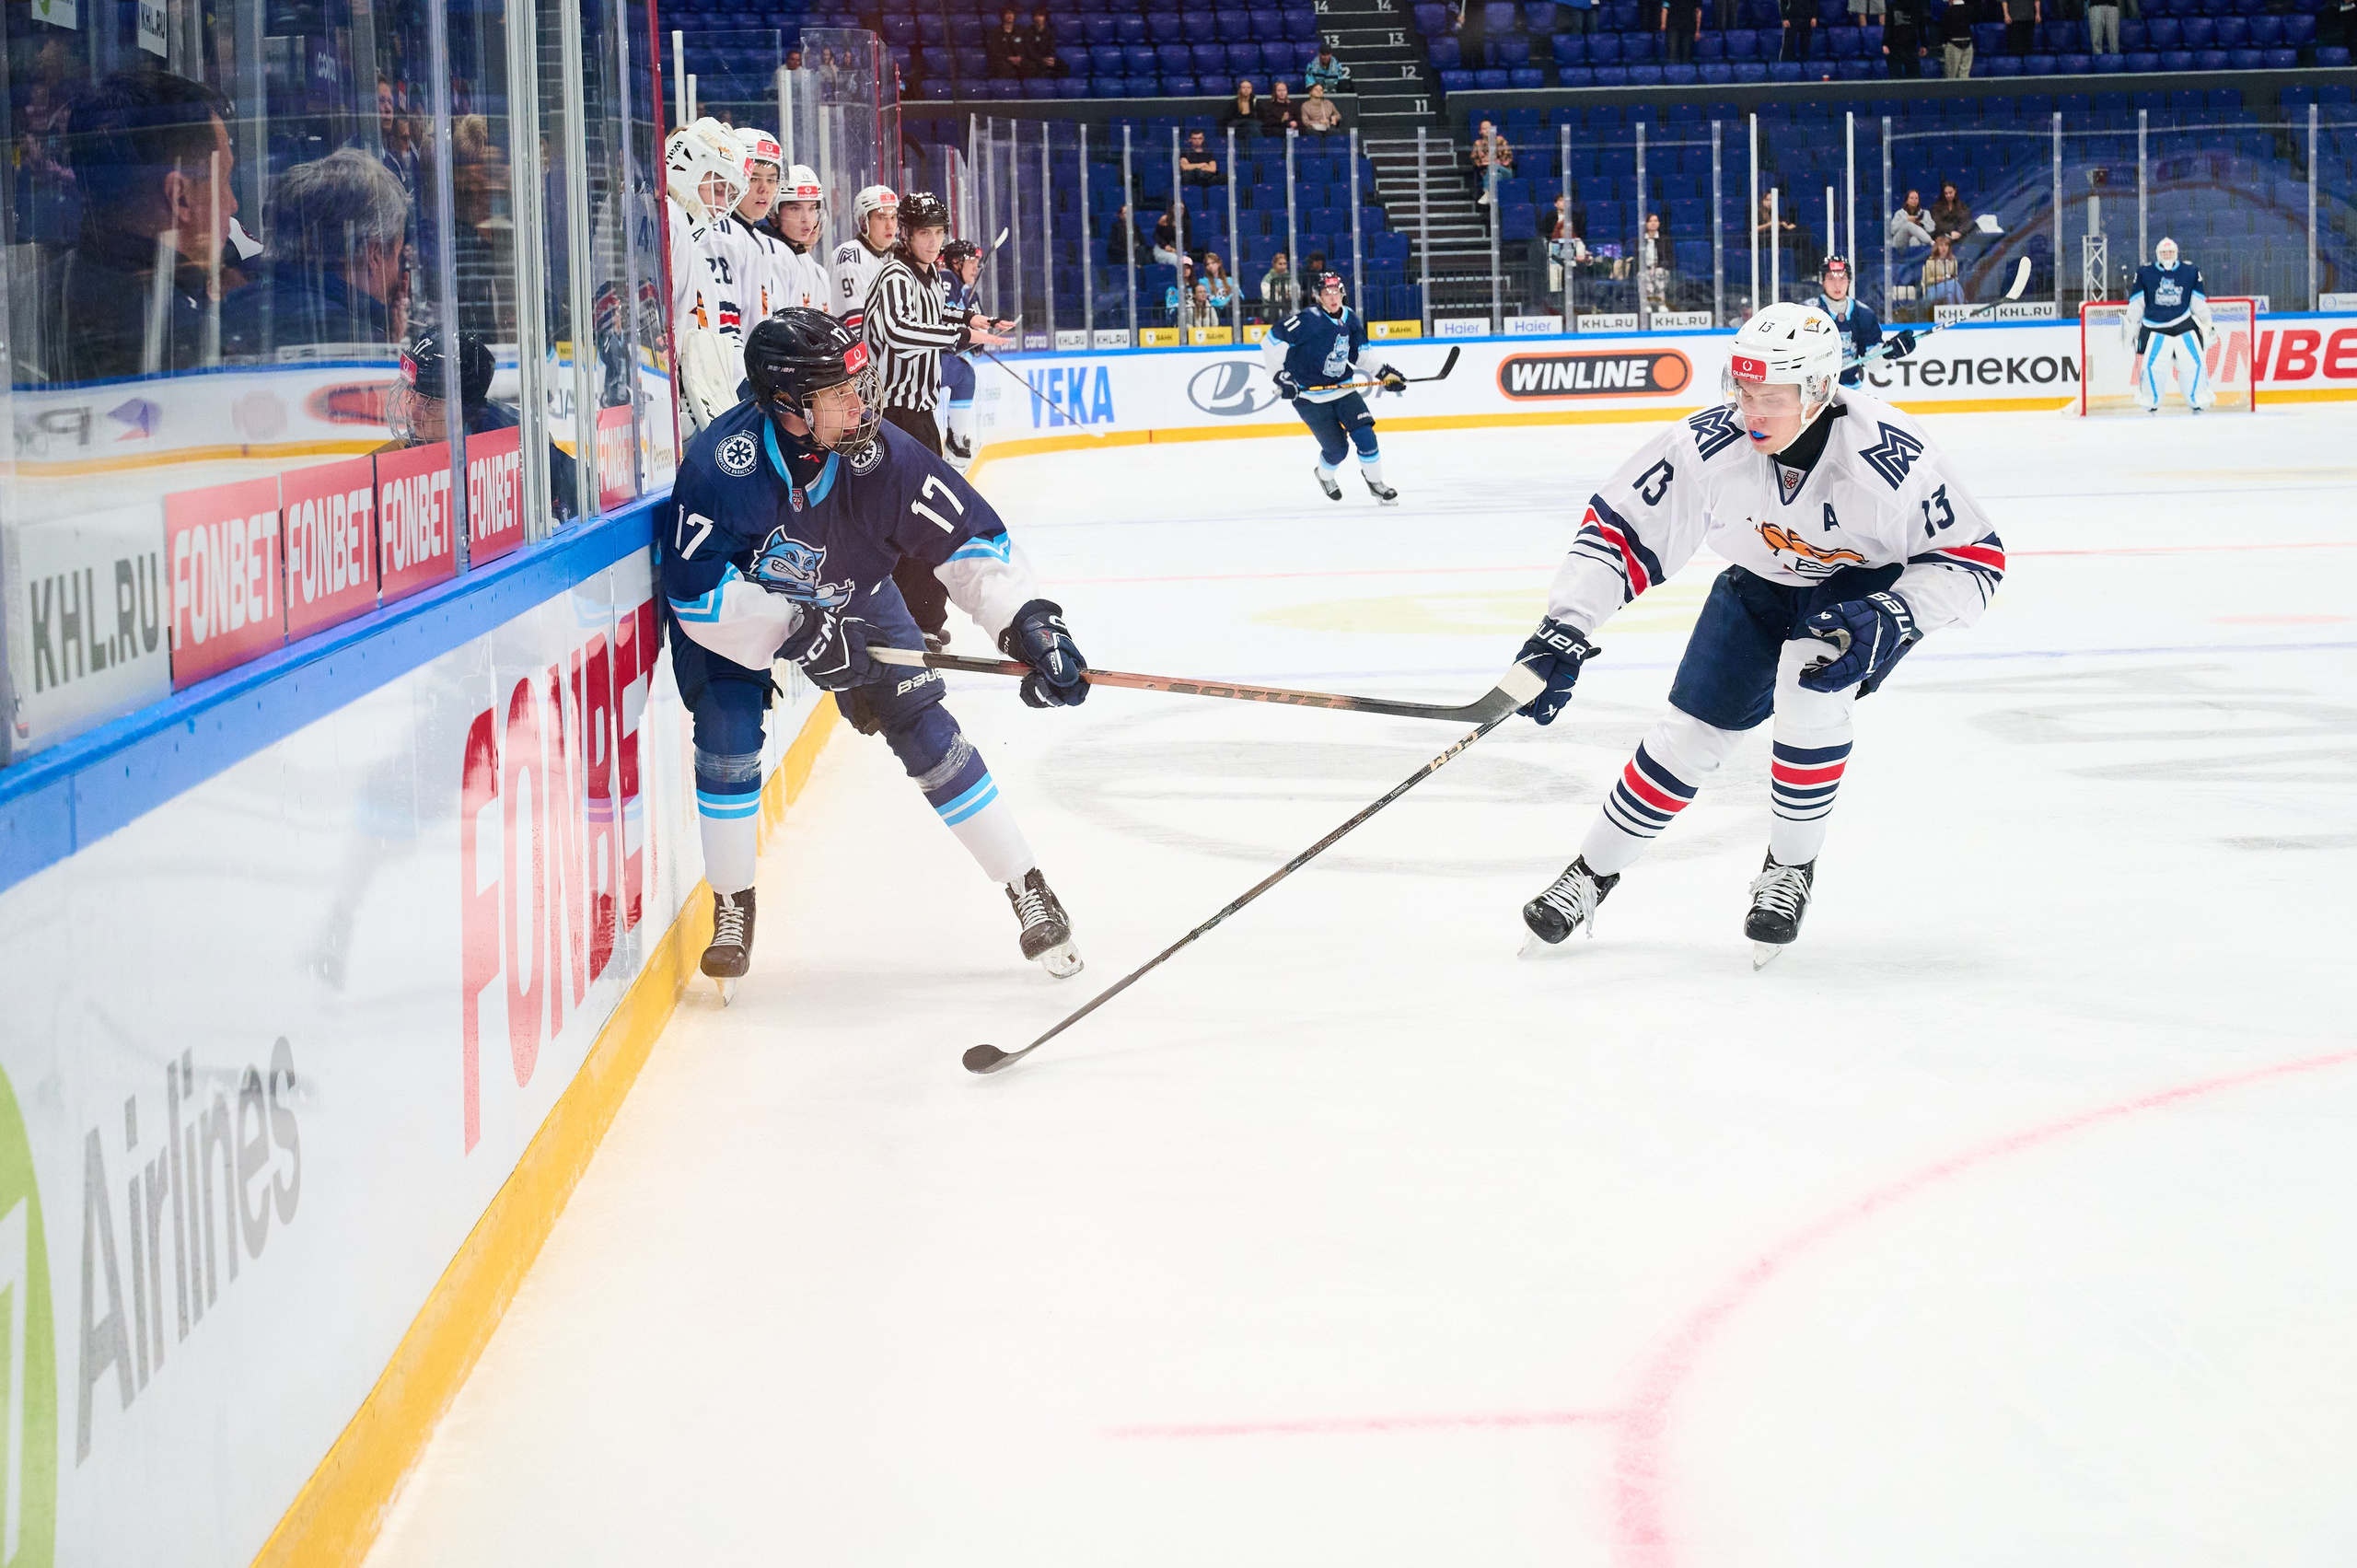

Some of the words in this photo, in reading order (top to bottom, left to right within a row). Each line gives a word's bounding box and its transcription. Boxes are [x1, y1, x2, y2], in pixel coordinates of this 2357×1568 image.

[1314, 0, 1329, 13] 14
[1376, 0, 1391, 11] 14
[1323, 35, 1340, 46] 13
[1388, 32, 1404, 44] 13
[1401, 66, 1416, 77] 12
[1415, 99, 1427, 111] 11
[1655, 316, 1708, 327] KHL.RU
[2000, 306, 2053, 317] KHL.RU
[830, 327, 851, 344] 17
[1445, 322, 1479, 335] Haier
[1515, 320, 1550, 333] Haier
[1582, 318, 1634, 330] KHL.RU
[1759, 321, 1775, 333] 13
[1096, 334, 1128, 345] KHL.RU
[1511, 360, 1648, 391] WINLINE
[1733, 370, 1763, 380] OLIMPBET
[1028, 366, 1115, 429] VEKA
[600, 424, 633, 493] FONBET
[1631, 457, 1674, 506] 13
[470, 449, 520, 543] FONBET
[911, 472, 965, 534] 17
[381, 469, 452, 575] FONBET
[1824, 502, 1840, 531] A
[1922, 483, 1956, 539] 13
[674, 503, 714, 561] 17
[287, 485, 375, 609] FONBET
[173, 510, 281, 651] FONBET
[30, 552, 160, 692] KHL.RU
[1050, 655, 1059, 676] CCM
[1167, 683, 1333, 708] SOYUZ
[1430, 730, 1478, 772] CCM
[76, 1035, 301, 1469] Airlines
